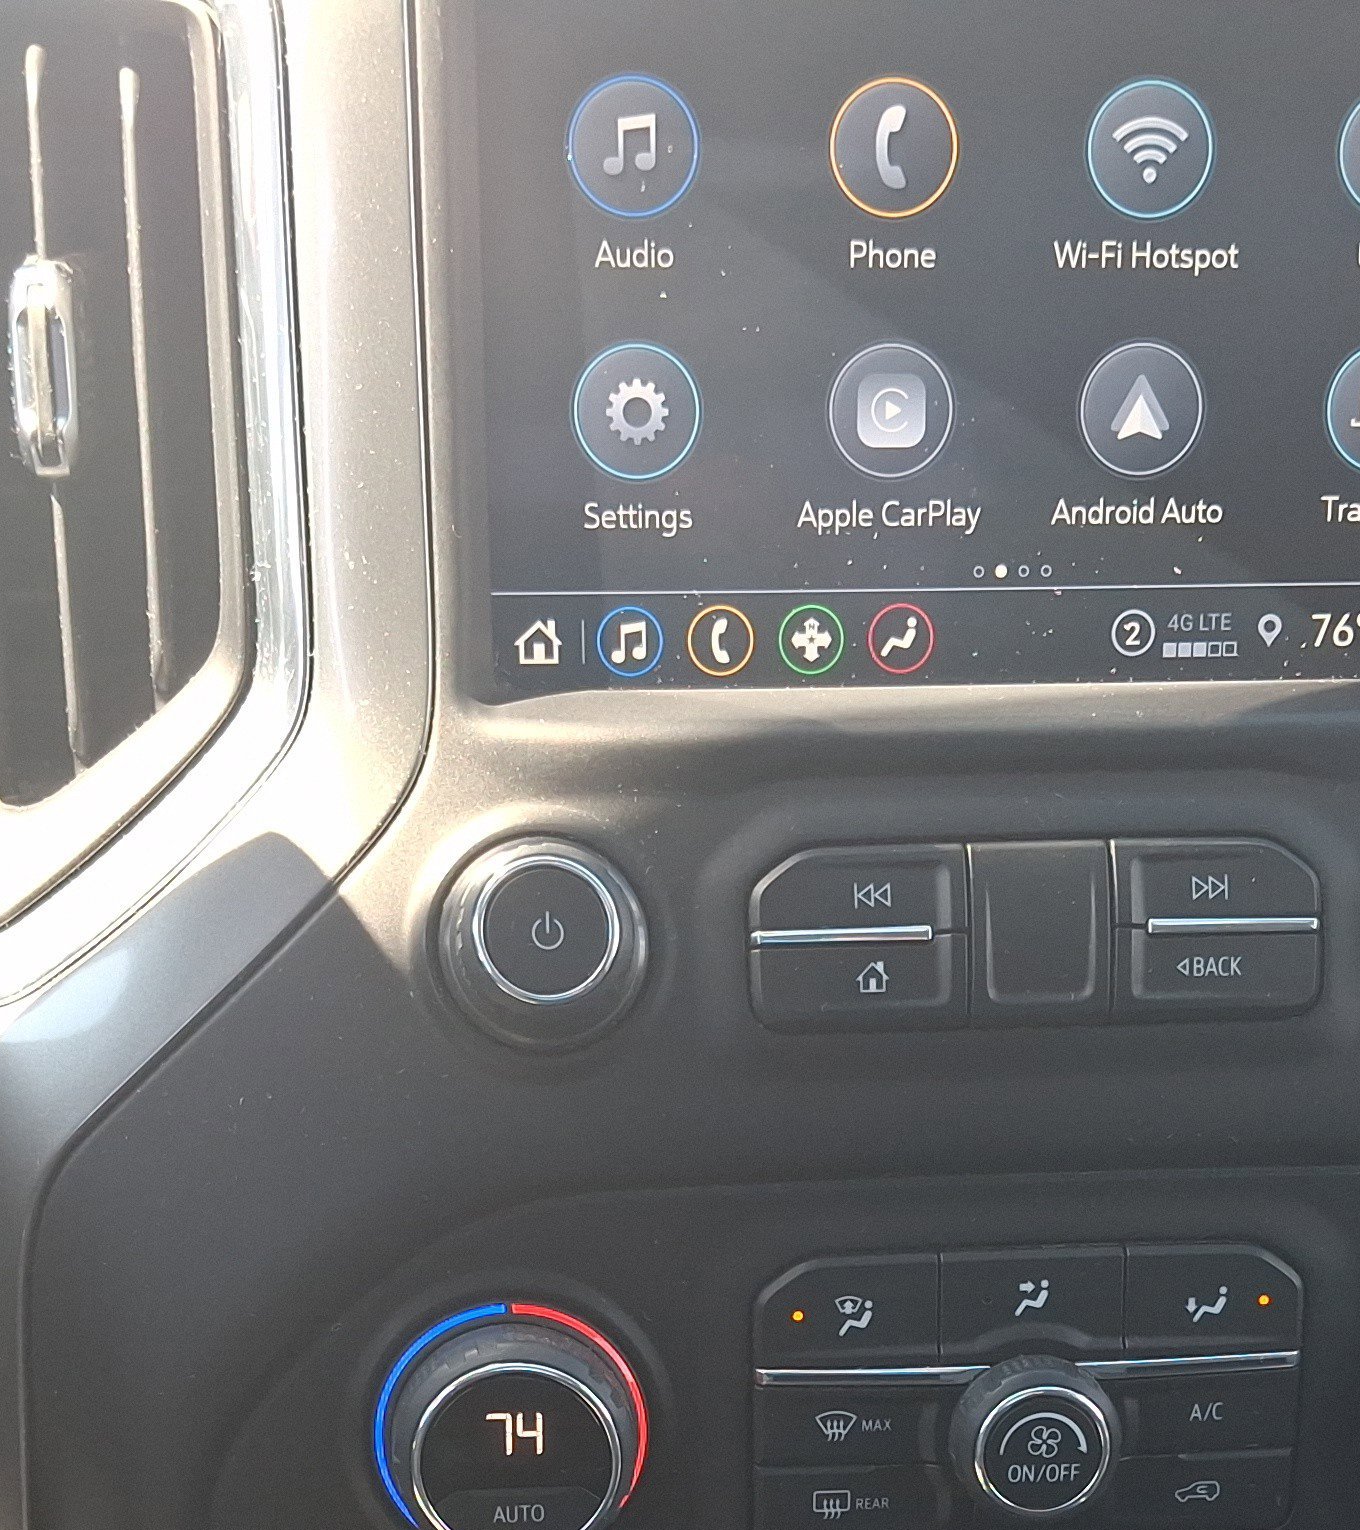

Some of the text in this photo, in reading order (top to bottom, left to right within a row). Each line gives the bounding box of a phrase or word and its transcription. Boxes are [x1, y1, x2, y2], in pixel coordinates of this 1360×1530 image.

[594, 238, 674, 269] Audio
[849, 239, 937, 269] Phone
[1053, 239, 1239, 276] Wi-Fi Hotspot
[583, 502, 693, 537] Settings
[797, 499, 981, 535] Apple CarPlay
[1051, 497, 1223, 526] Android Auto
[1123, 621, 1141, 647] 2
[1167, 613, 1232, 632] 4G LTE
[1192, 956, 1242, 977] BACK
[1188, 1401, 1224, 1422] A/C
[485, 1412, 544, 1456] 74
[861, 1418, 892, 1433] MAX
[1007, 1463, 1081, 1484] ON/OFF
[493, 1504, 545, 1523] AUTO
[855, 1497, 889, 1511] REAR
